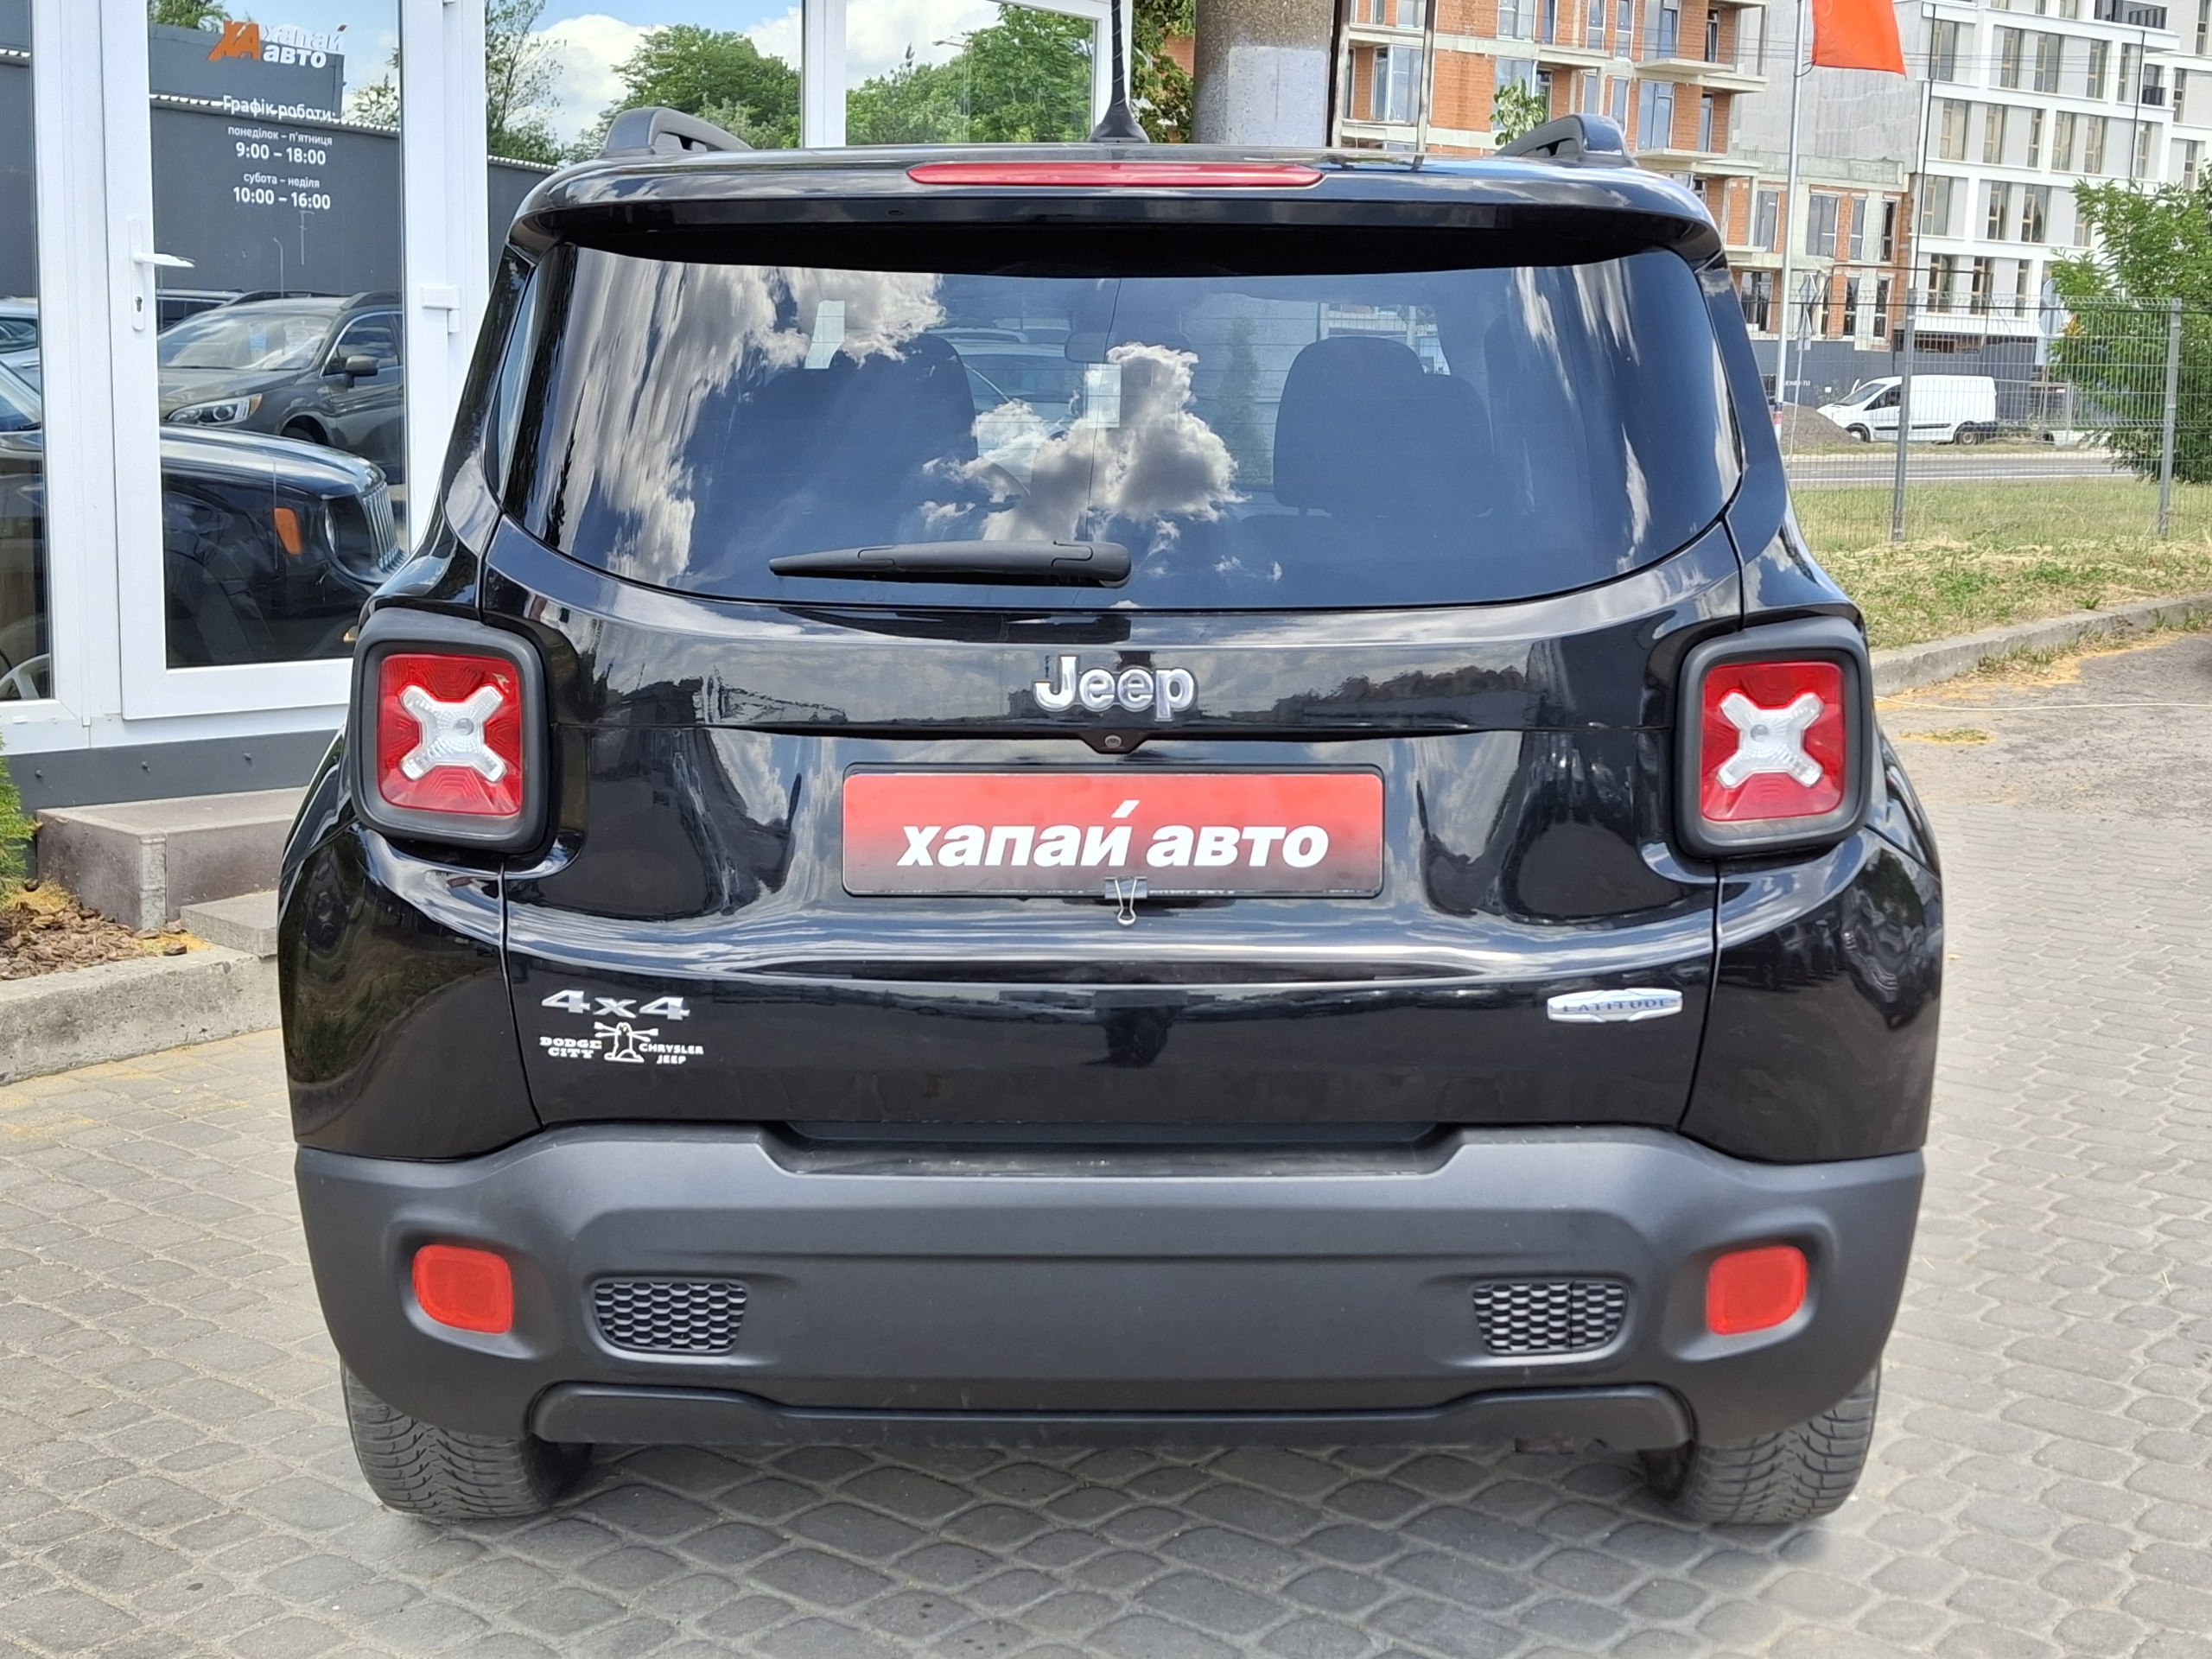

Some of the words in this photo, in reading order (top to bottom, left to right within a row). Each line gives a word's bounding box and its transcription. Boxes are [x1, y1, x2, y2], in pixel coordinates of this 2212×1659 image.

[263, 44, 327, 68] авто
[223, 95, 274, 118] Графік
[228, 126, 279, 140] понеділок
[235, 142, 270, 160] 9:00
[286, 147, 327, 166] 18:00
[244, 172, 277, 185] субота
[288, 176, 320, 188] неділя
[233, 187, 275, 206] 10:00
[290, 192, 331, 210] 16:00
[1035, 654, 1198, 721] Jeep
[897, 800, 1141, 867] хапай
[1146, 823, 1330, 868] авто
[1562, 998, 1669, 1013] LATITUDE
[539, 1036, 603, 1050] DODGE
[639, 1042, 704, 1056] CHRYSLER
[547, 1046, 595, 1059] CITY
[656, 1054, 687, 1065] JEEP
